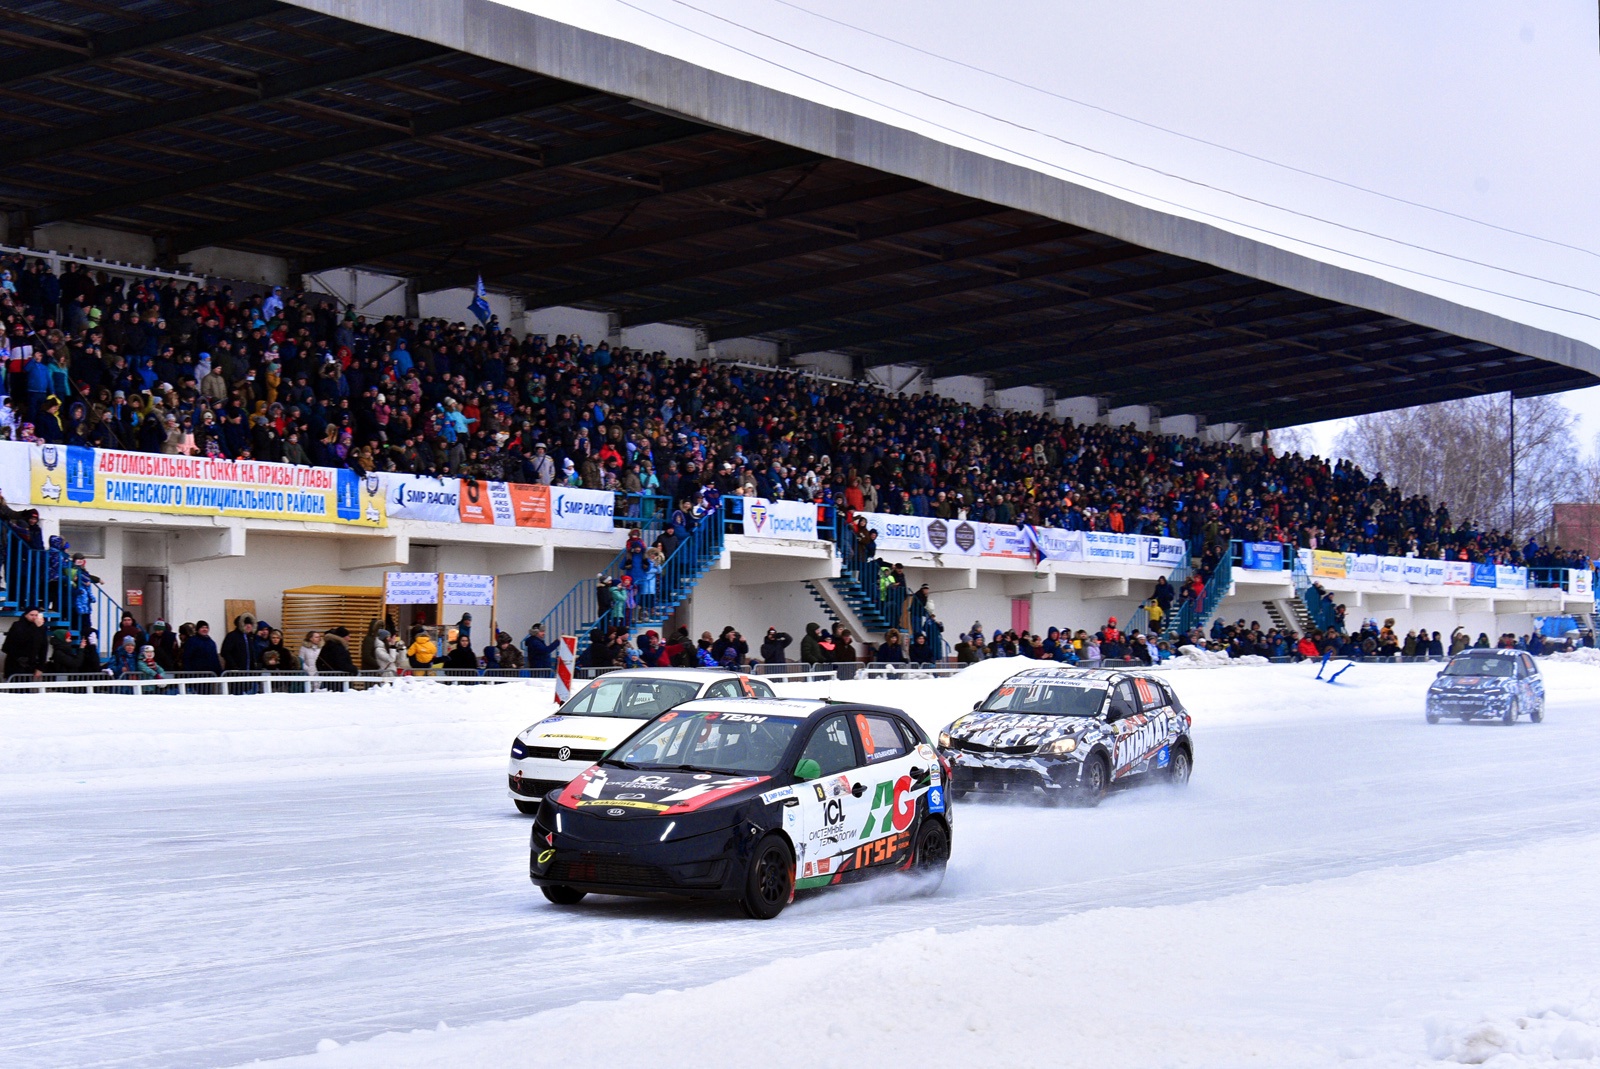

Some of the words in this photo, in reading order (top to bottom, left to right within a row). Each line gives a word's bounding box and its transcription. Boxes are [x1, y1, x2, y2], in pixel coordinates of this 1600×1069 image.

[99, 452, 200, 479] АВТОМОБИЛЬНЫЕ
[204, 461, 238, 482] ГОНКИ
[241, 464, 255, 483] НА
[258, 465, 294, 486] ПРИЗЫ
[296, 469, 333, 489] ГЛАВЫ
[106, 480, 183, 505] РАМЕНСКОГО
[186, 486, 284, 511] МУНИЦИПАЛЬНОГО
[287, 490, 325, 514] РАЙОНА
[407, 490, 426, 502] SMP
[428, 492, 457, 506] RACING
[565, 501, 582, 514] SMP
[584, 503, 613, 517] RACING
[885, 523, 921, 539] SIBELCO
[998, 687, 1016, 696] 10
[1134, 677, 1153, 704] 10
[659, 711, 679, 723] 8
[720, 712, 768, 724] TEAM
[855, 713, 875, 754] 8
[1117, 711, 1168, 771] AKHMAT
[768, 792, 778, 800] SMP
[777, 788, 793, 798] RACING
[816, 786, 824, 799] 8
[608, 808, 625, 816] KIA
[823, 798, 846, 826] ICL
[858, 775, 916, 840] AG
[809, 822, 844, 841] СИСТЕМНЫЕ
[855, 834, 898, 869] ITSF
